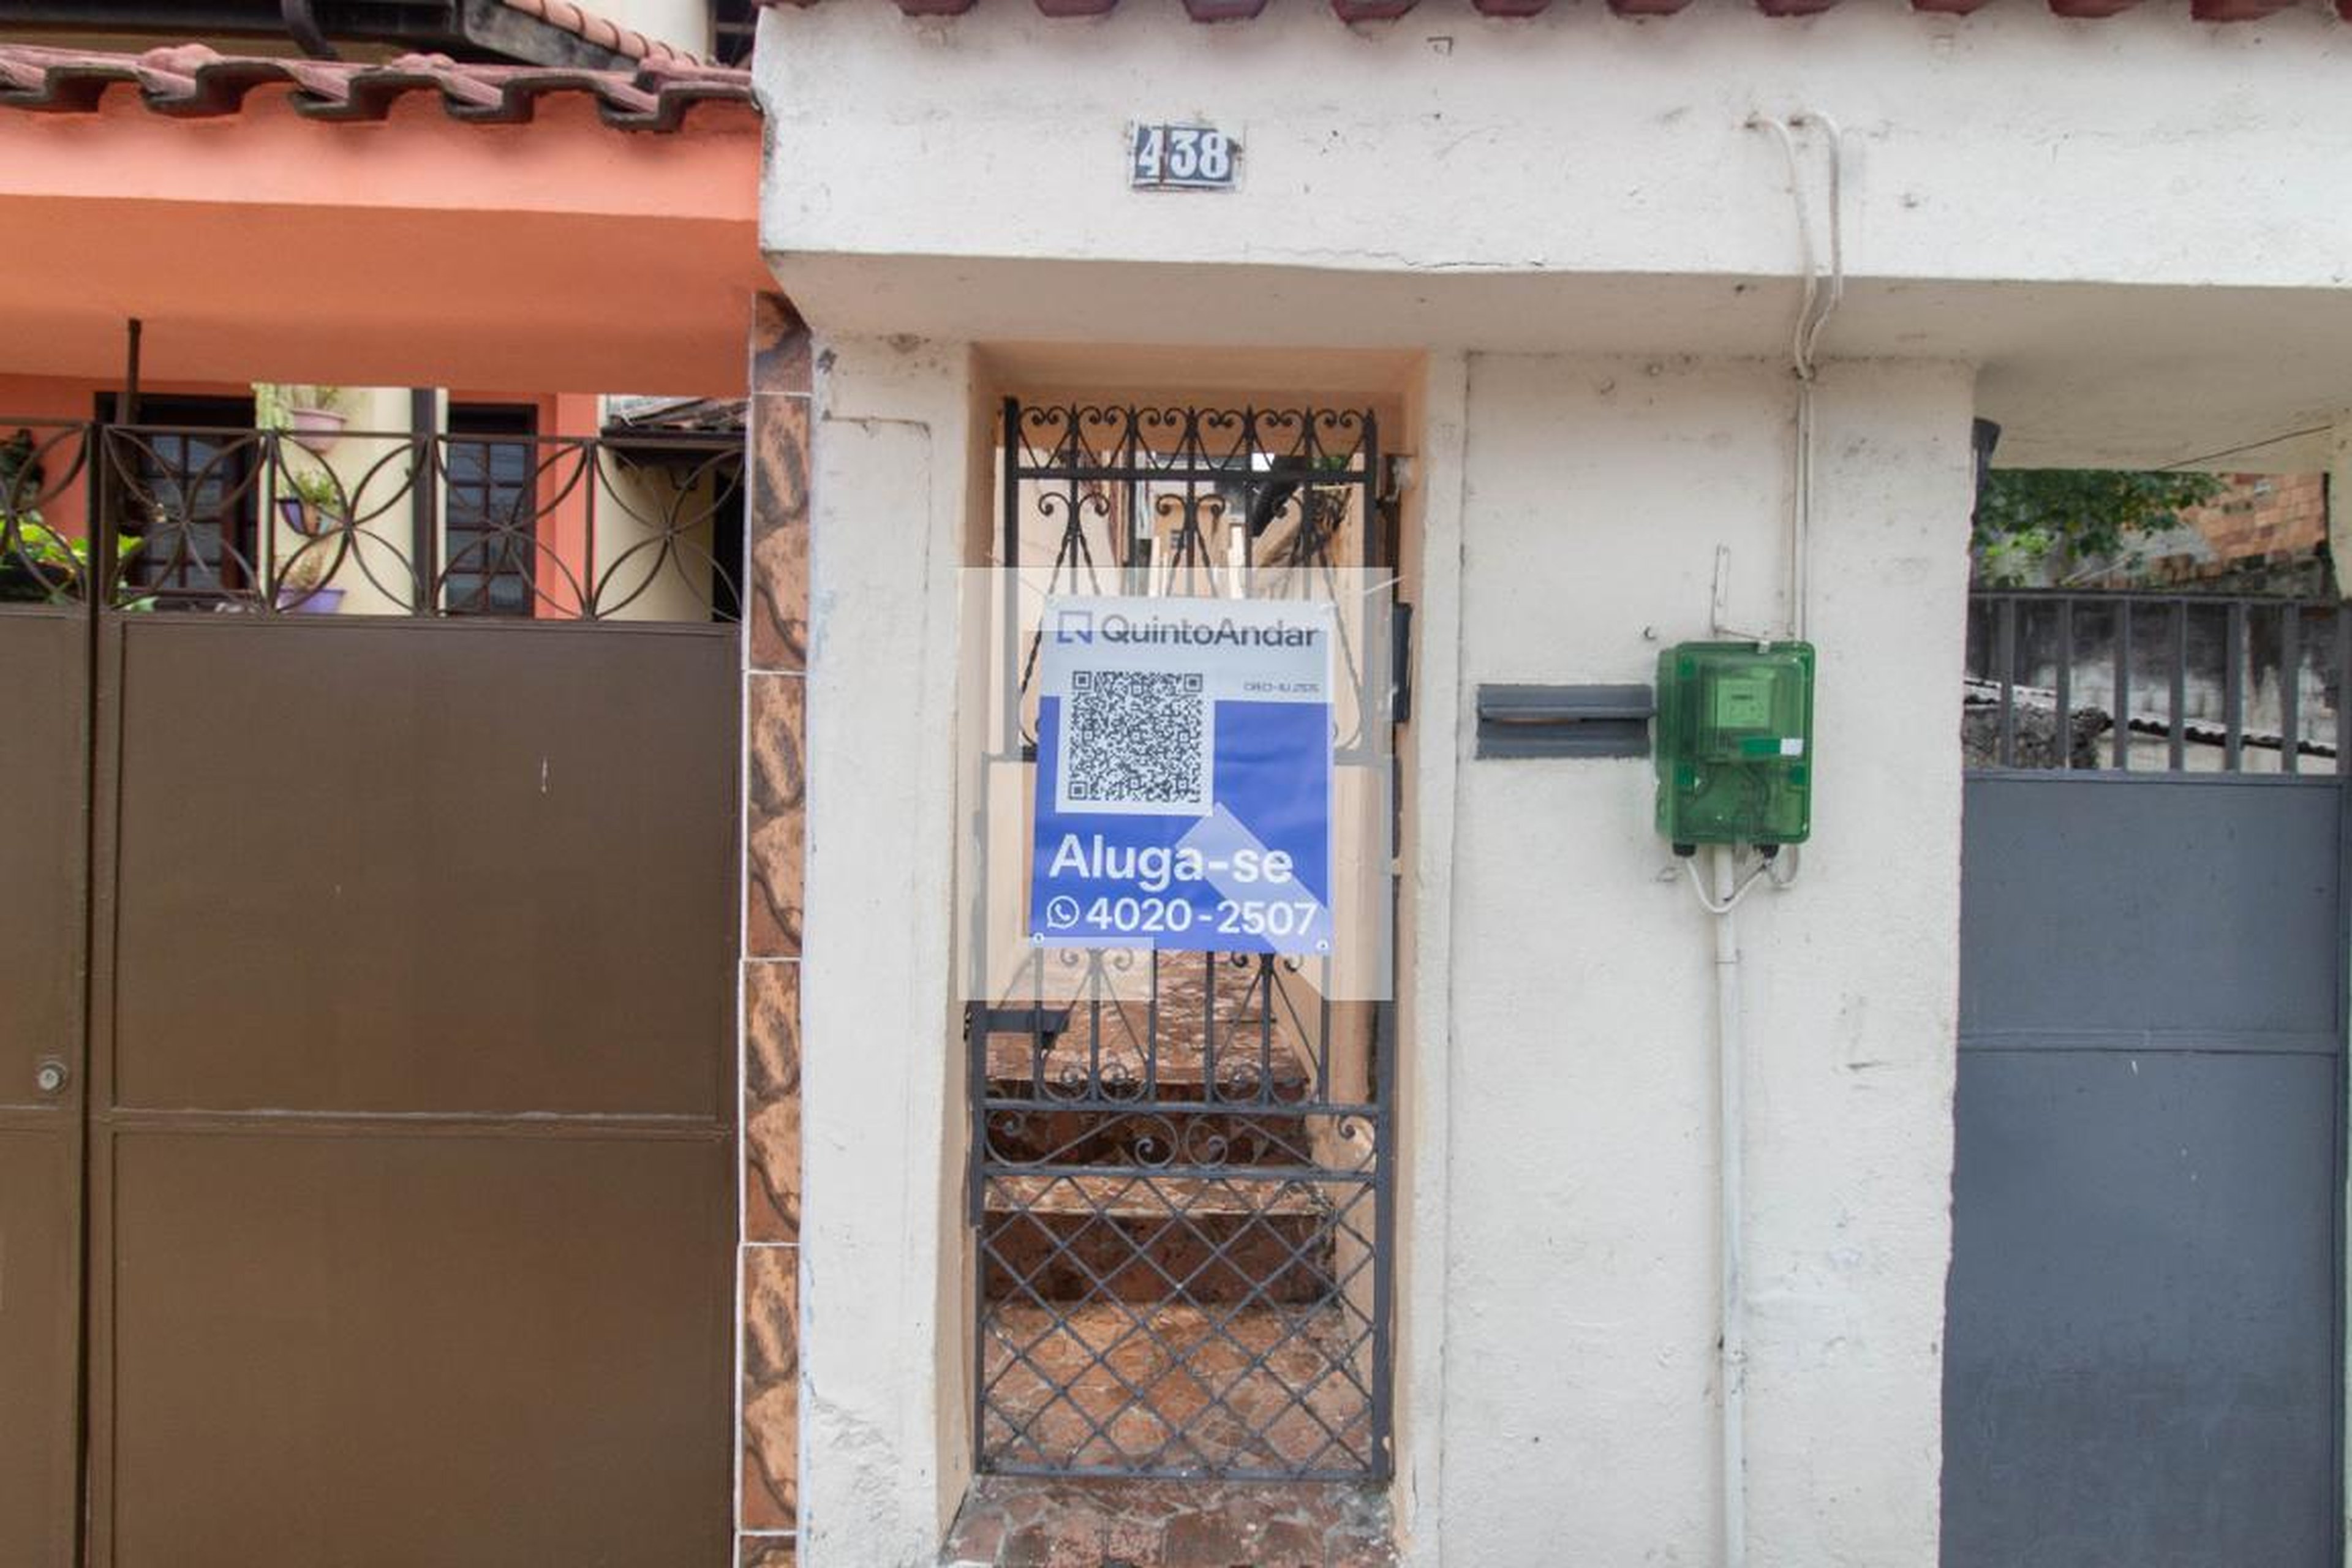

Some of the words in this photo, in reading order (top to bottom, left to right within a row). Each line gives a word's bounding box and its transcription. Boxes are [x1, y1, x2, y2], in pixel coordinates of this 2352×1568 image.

[1138, 129, 1229, 178] 438
[1102, 614, 1319, 647] QuintoAndar
[1049, 833, 1294, 892] Aluga-se
